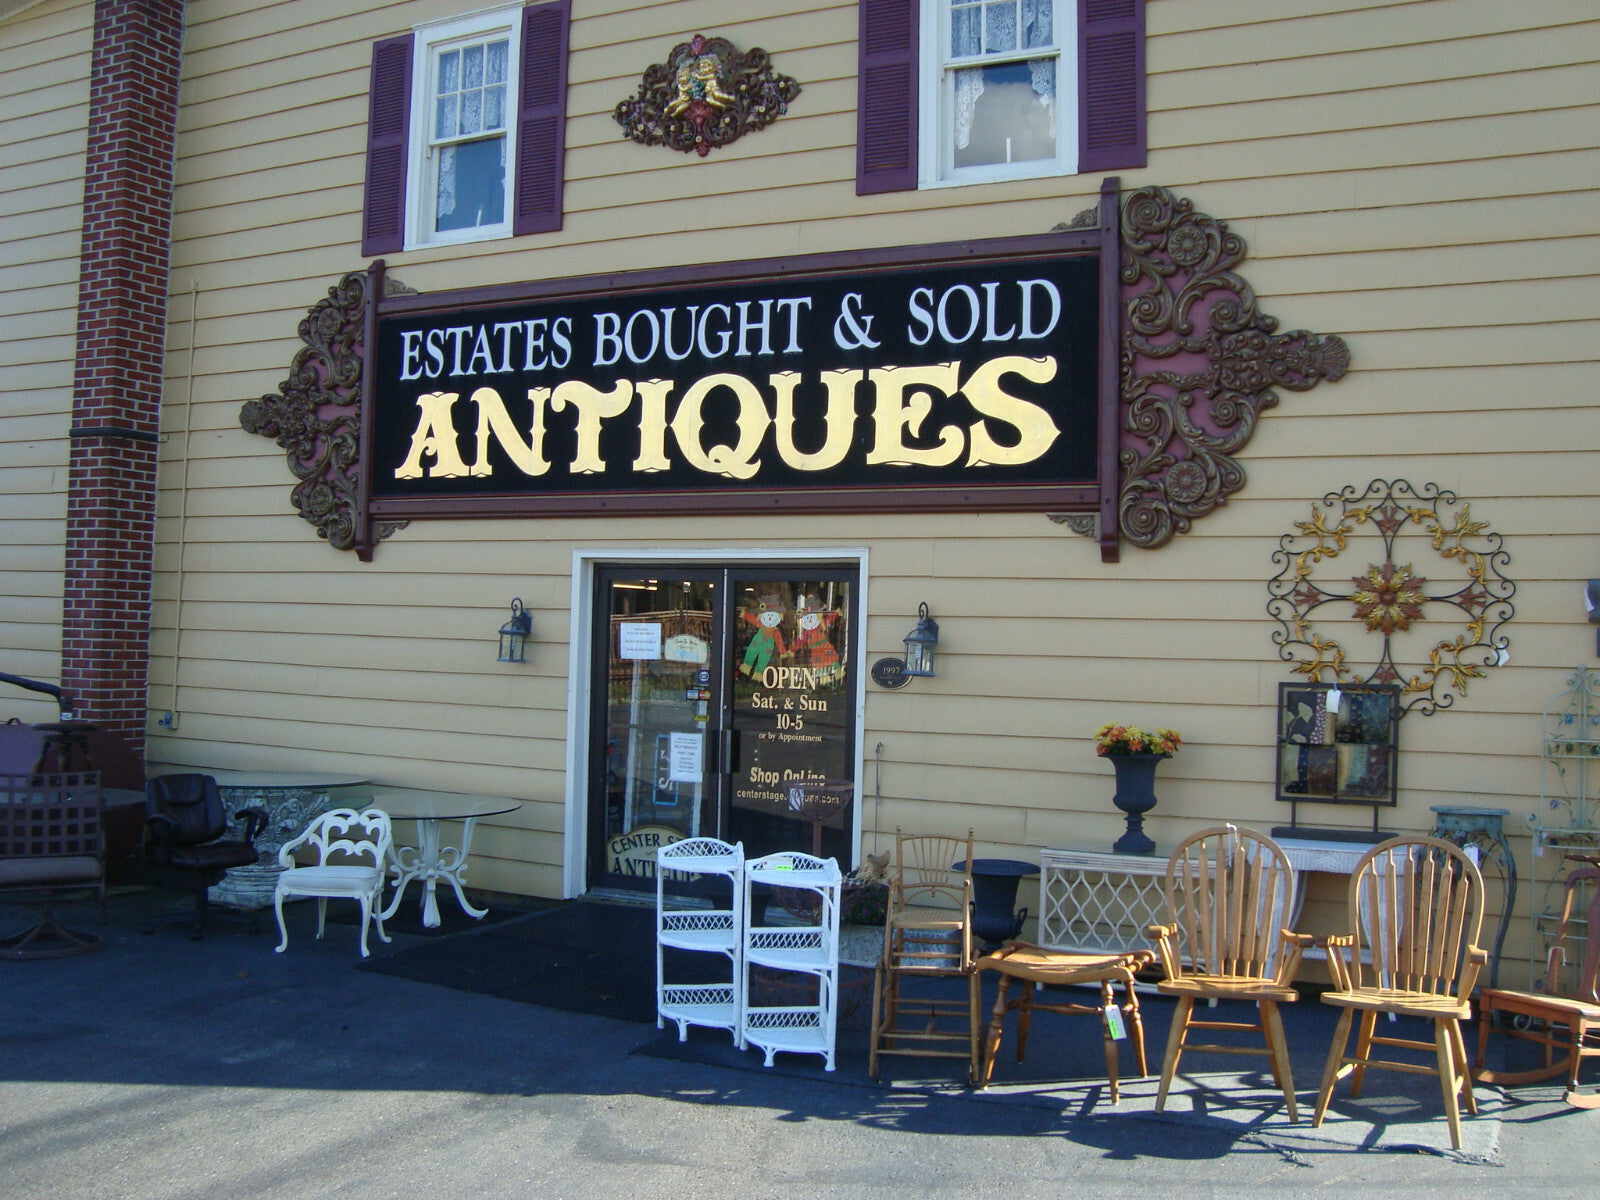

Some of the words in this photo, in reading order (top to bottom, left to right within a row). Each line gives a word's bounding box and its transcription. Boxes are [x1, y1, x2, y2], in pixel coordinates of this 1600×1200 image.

[400, 317, 572, 381] ESTATES
[593, 297, 812, 366] BOUGHT
[834, 292, 881, 349] &
[908, 279, 1061, 345] SOLD
[394, 356, 1062, 480] ANTIQUES
[762, 666, 817, 690] OPEN
[752, 692, 778, 709] Sat.
[784, 698, 794, 710] &
[800, 694, 827, 711] Sun
[776, 713, 803, 730] 10-5
[768, 731, 776, 741] by
[778, 733, 822, 743] Appointment
[749, 766, 780, 787] Shop
[611, 833, 661, 855] CENTER
